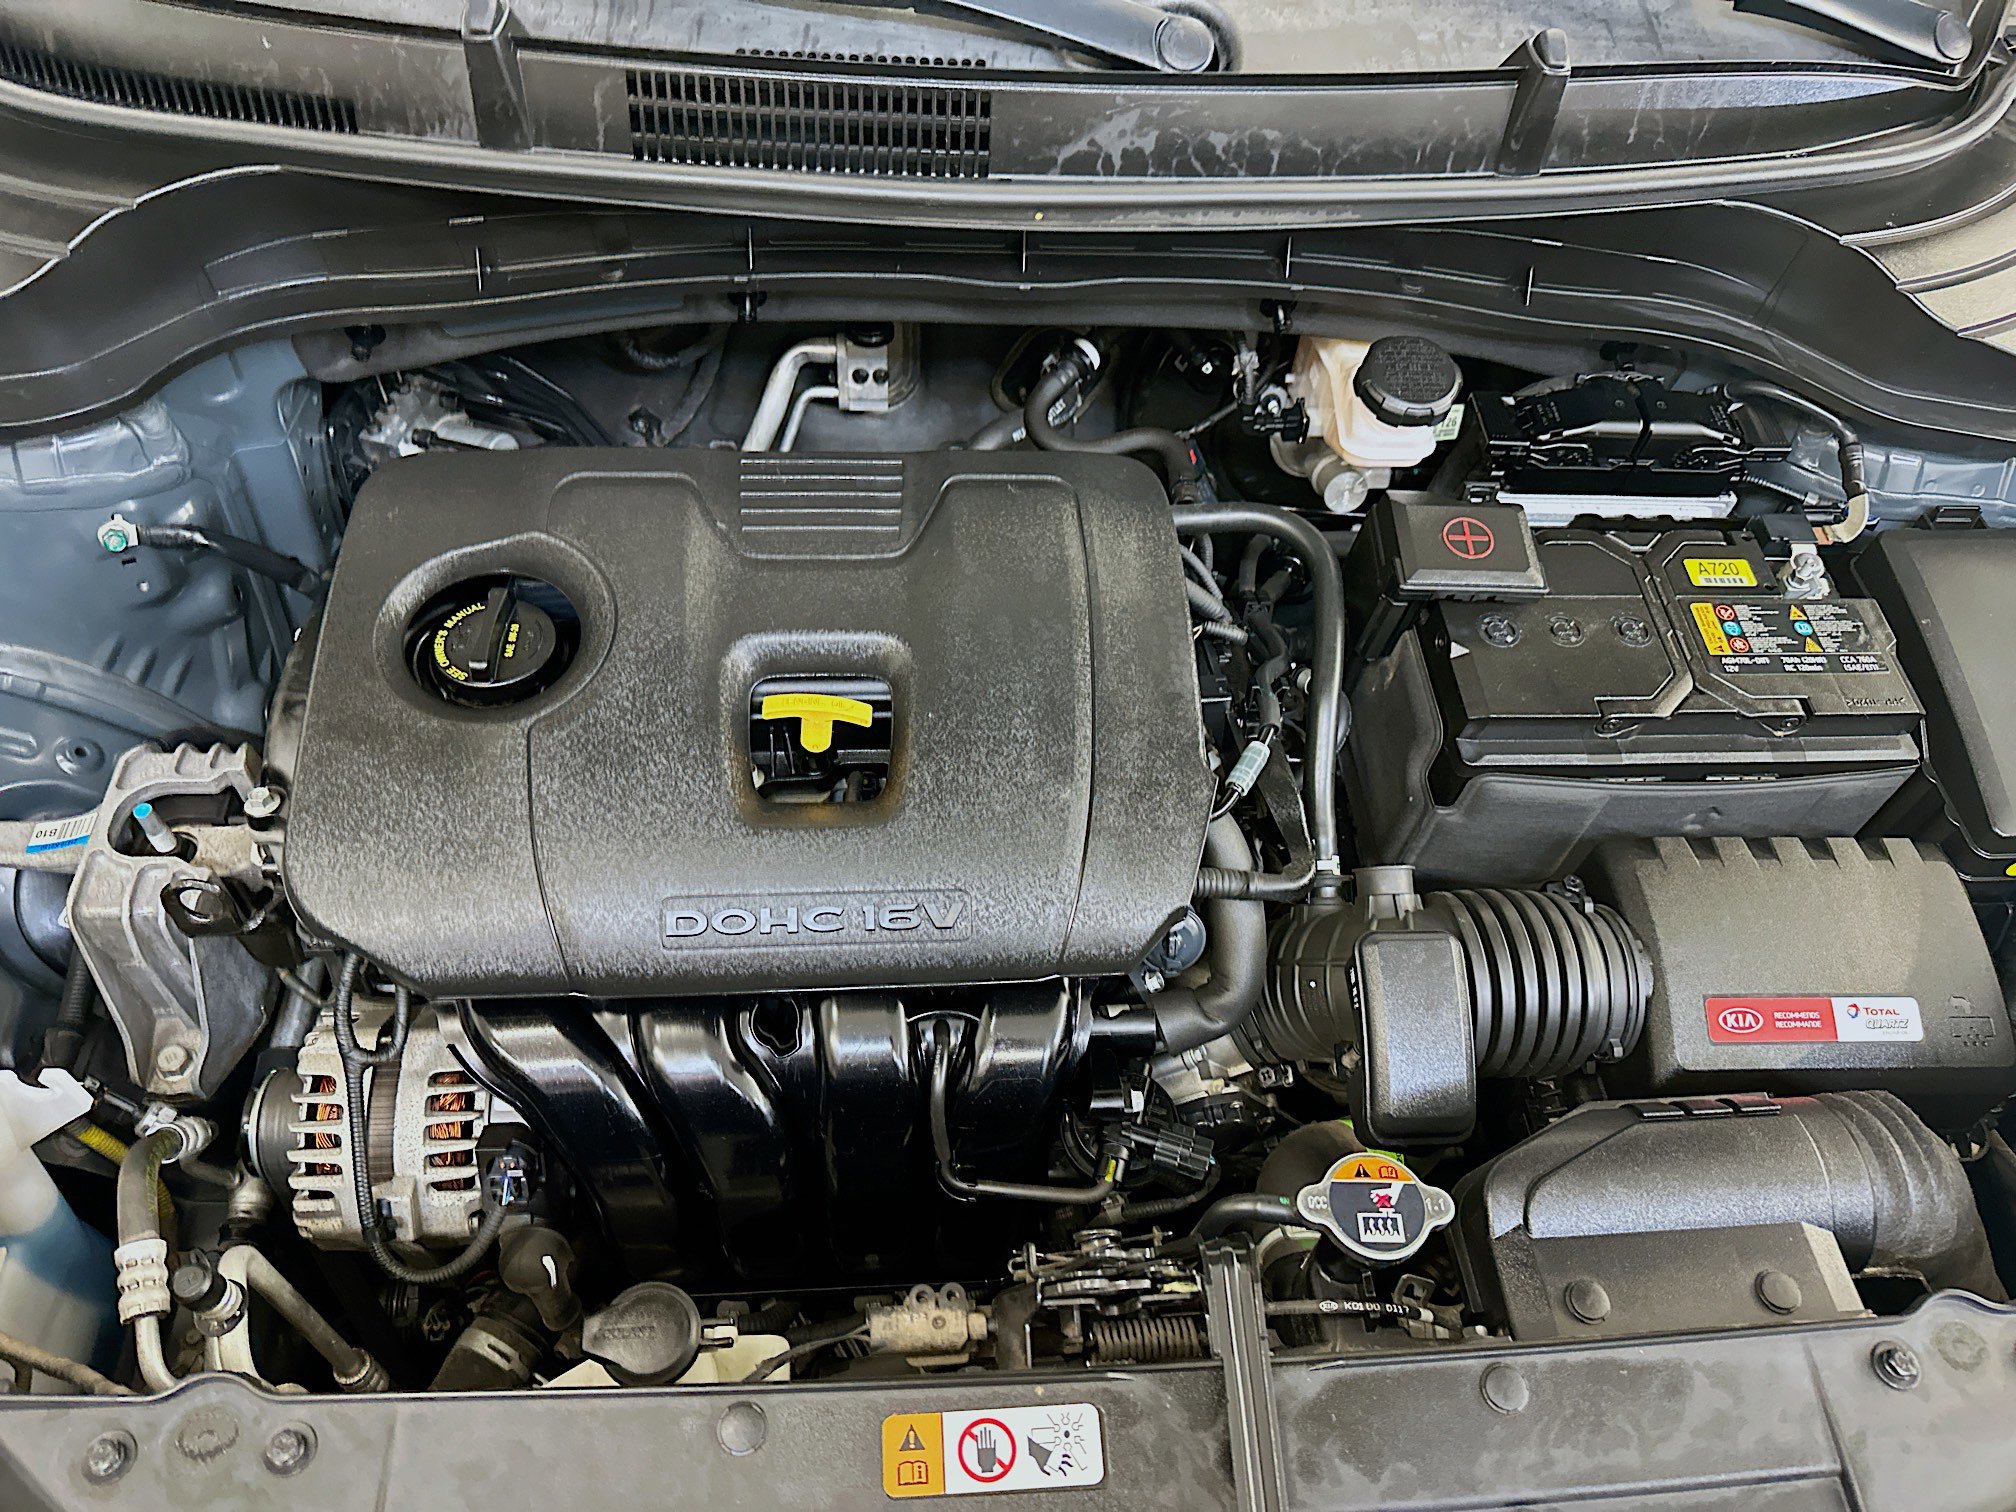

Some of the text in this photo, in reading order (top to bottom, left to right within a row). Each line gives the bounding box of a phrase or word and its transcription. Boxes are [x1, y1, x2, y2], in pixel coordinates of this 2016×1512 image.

[1699, 562, 1740, 576] A720
[434, 603, 485, 681] SEE OWNER'S MANUAL
[504, 644, 516, 657] SAE
[1839, 655, 1857, 664] CCA
[1857, 655, 1878, 664] 760A
[1723, 665, 1739, 673] 12V
[35, 828, 58, 839] B10
[665, 900, 965, 937] DOHC 16V
[1773, 1011, 1820, 1020] RECOMMENDS
[1863, 1007, 1900, 1016] TOTAL
[1725, 1013, 1757, 1028] KIA
[1775, 1020, 1822, 1029] RECOMMANDE
[1865, 1018, 1909, 1030] QUARTZ
